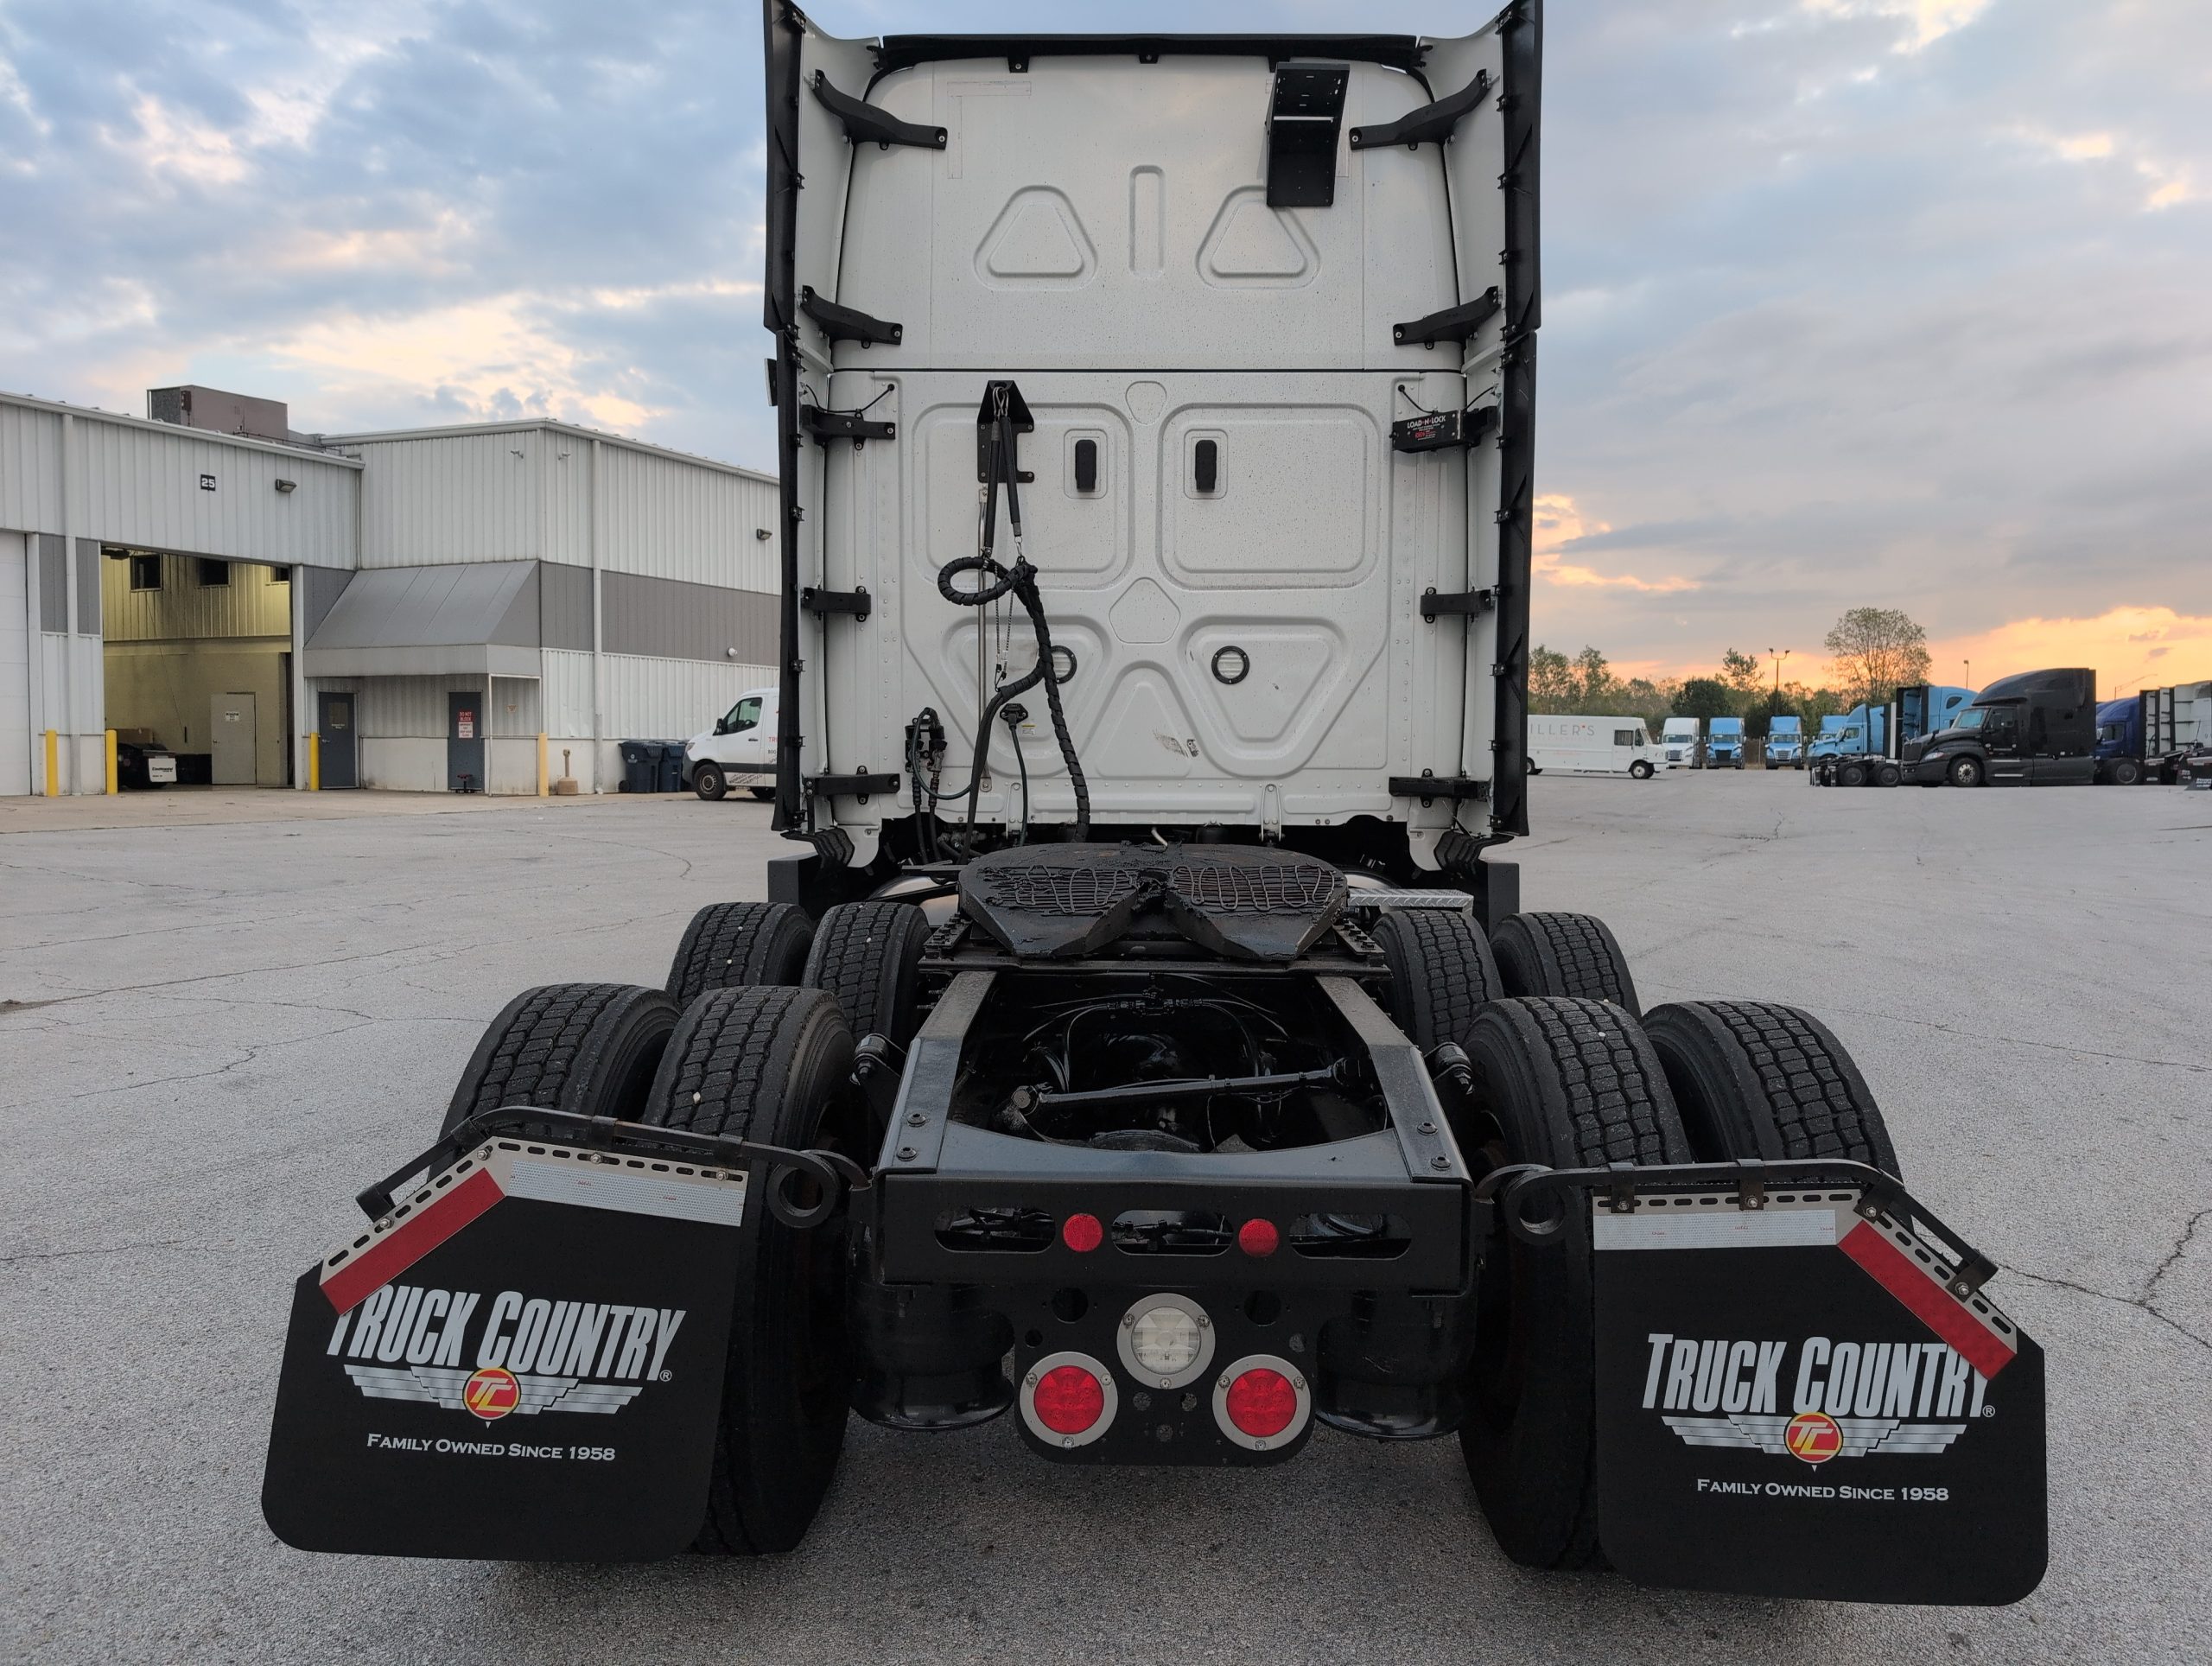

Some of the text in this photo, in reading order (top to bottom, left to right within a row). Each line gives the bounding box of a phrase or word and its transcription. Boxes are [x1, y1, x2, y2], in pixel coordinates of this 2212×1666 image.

[202, 478, 214, 487] 25
[1530, 723, 1595, 736] ILLER'S
[476, 1291, 687, 1381] COUNTRY
[1643, 1333, 1787, 1413] TRUCK
[569, 1447, 615, 1460] 1958
[1901, 1488, 1949, 1501] 1958
